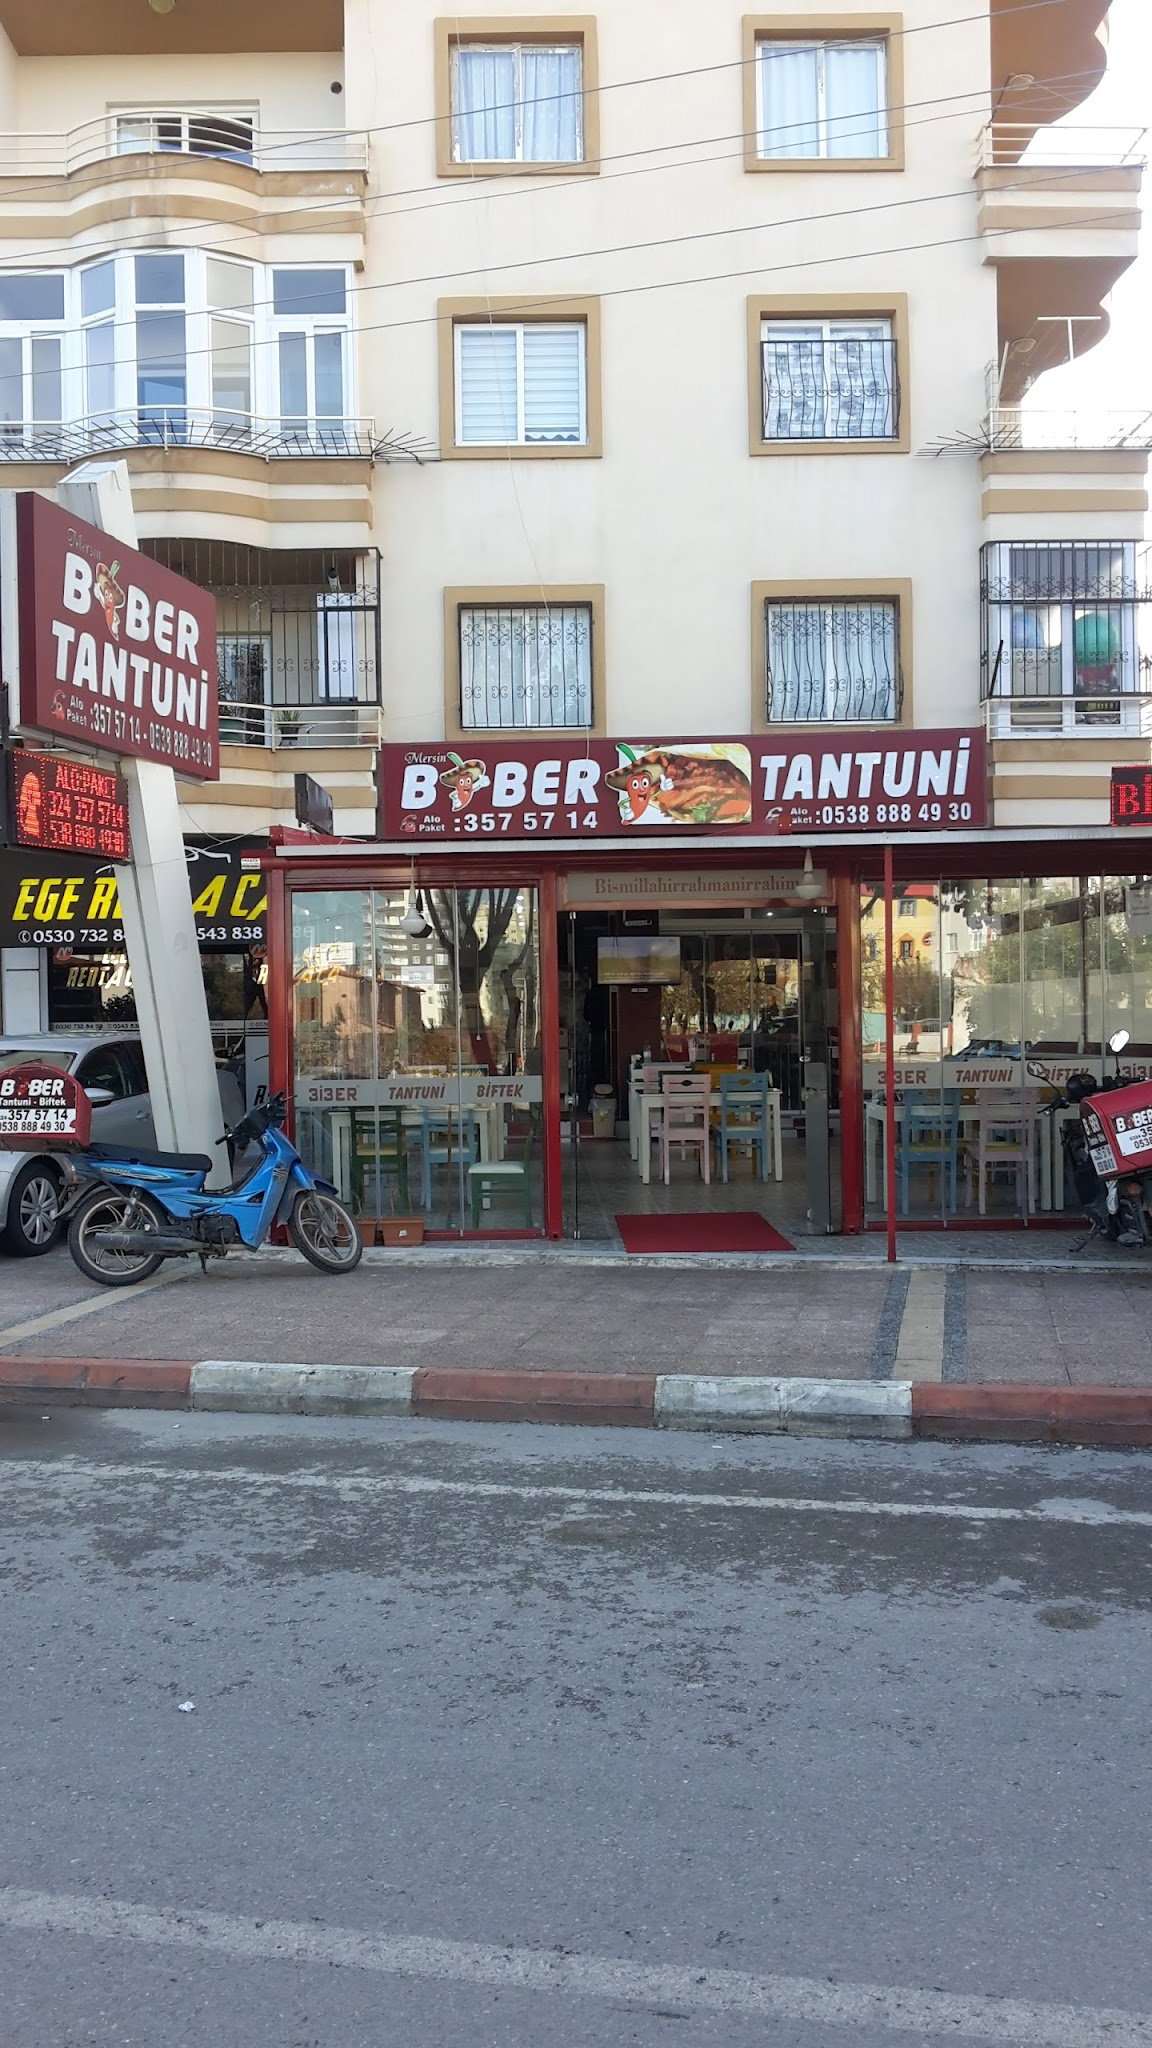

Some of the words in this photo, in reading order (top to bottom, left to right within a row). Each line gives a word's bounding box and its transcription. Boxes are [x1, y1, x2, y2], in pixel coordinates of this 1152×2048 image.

[70, 695, 84, 710] Alo
[66, 709, 88, 727] Paket
[114, 709, 126, 740] 57
[129, 715, 141, 745] 14
[174, 730, 189, 760] 888
[404, 752, 447, 764] Mersin
[791, 807, 808, 816] Alo
[876, 803, 911, 823] 888
[918, 803, 942, 822] 49
[948, 802, 972, 821] 30
[423, 815, 441, 824] Alo
[523, 812, 555, 831] 57
[566, 811, 598, 829] 14
[791, 816, 813, 824] aket
[419, 823, 446, 832] Paket
[12, 878, 85, 923] EGE
[192, 875, 227, 918] A
[33, 929, 75, 943] 0530
[80, 928, 108, 942] 732
[112, 928, 126, 942] 8
[231, 926, 263, 940] 838
[39, 1097, 66, 1106] Biftek
[8, 1109, 30, 1121] 357
[35, 1109, 49, 1121] 57
[54, 1109, 68, 1120] 14
[21, 1121, 37, 1132] 888
[40, 1121, 51, 1132] 49
[54, 1121, 65, 1132] 30
